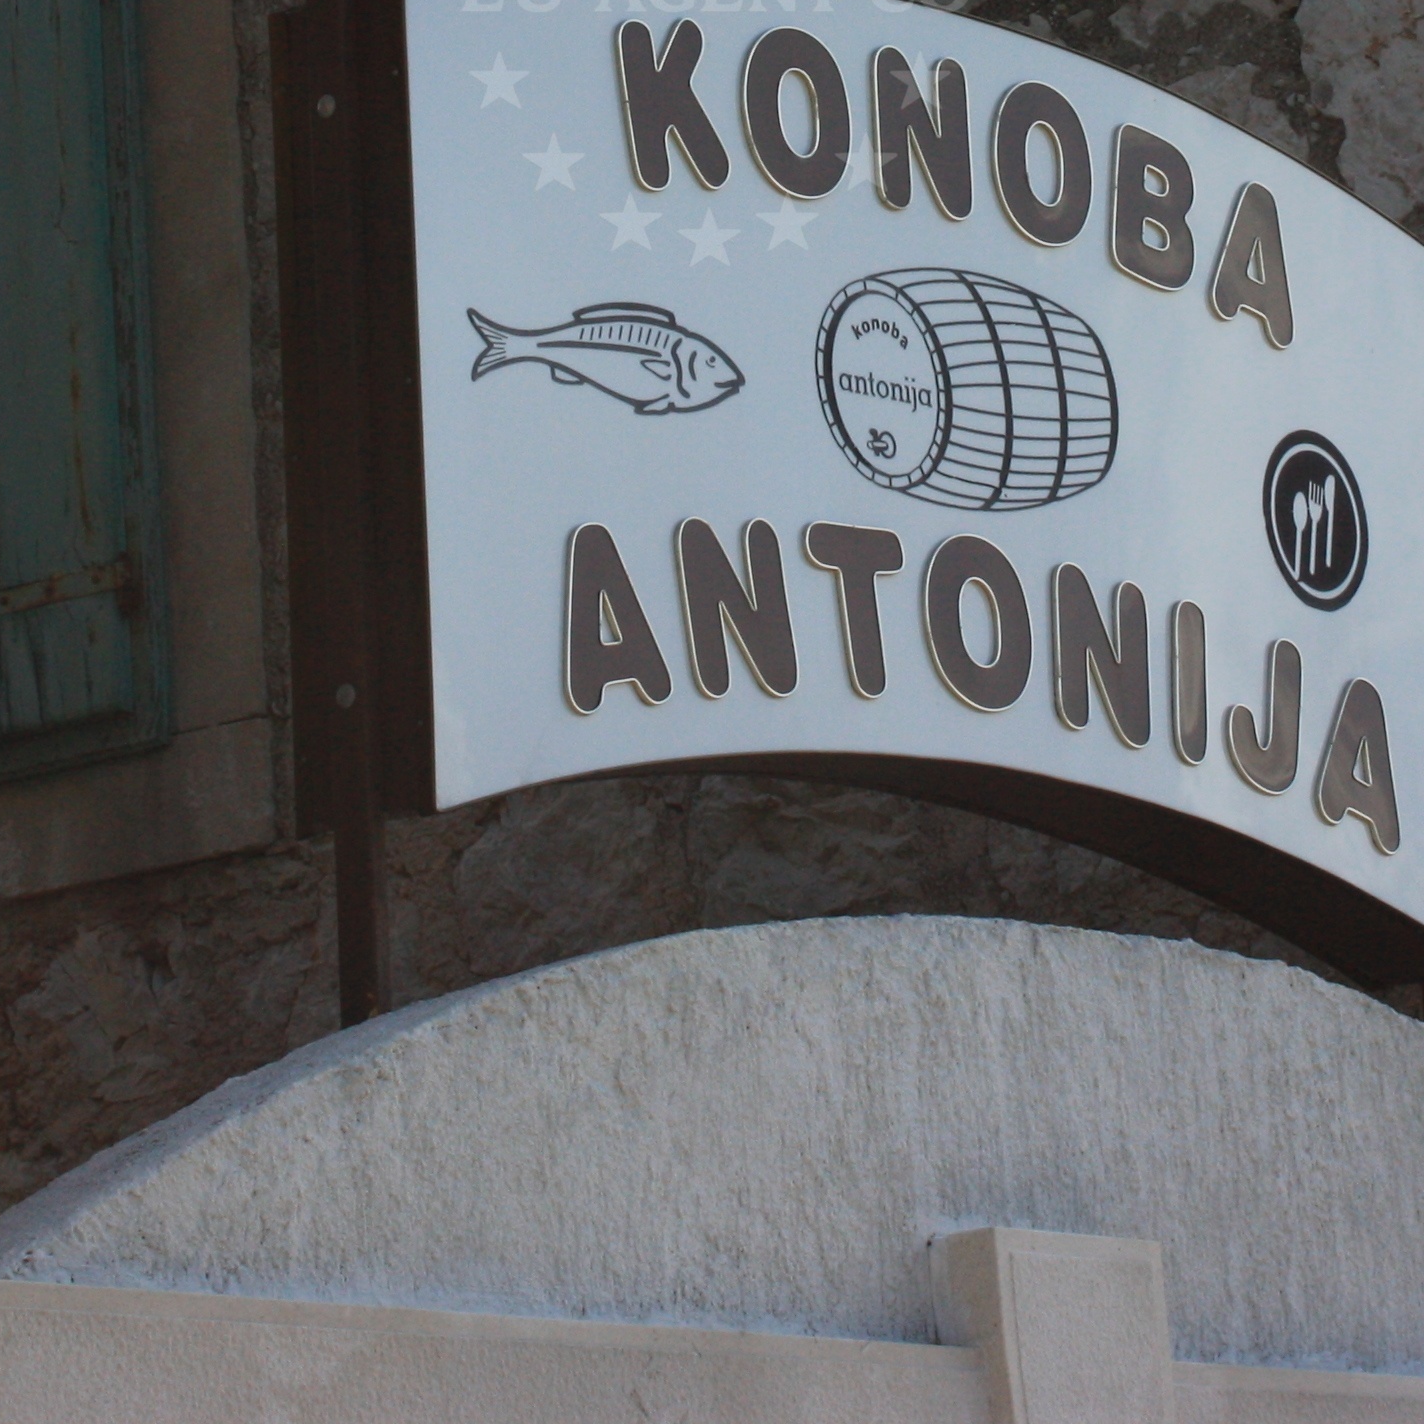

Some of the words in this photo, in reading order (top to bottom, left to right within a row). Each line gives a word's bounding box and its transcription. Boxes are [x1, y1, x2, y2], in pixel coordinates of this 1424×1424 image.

[616, 17, 1294, 350] KONOBA
[838, 371, 933, 413] antonija
[850, 317, 909, 350] konoba
[564, 516, 1401, 855] ANTONIJA
